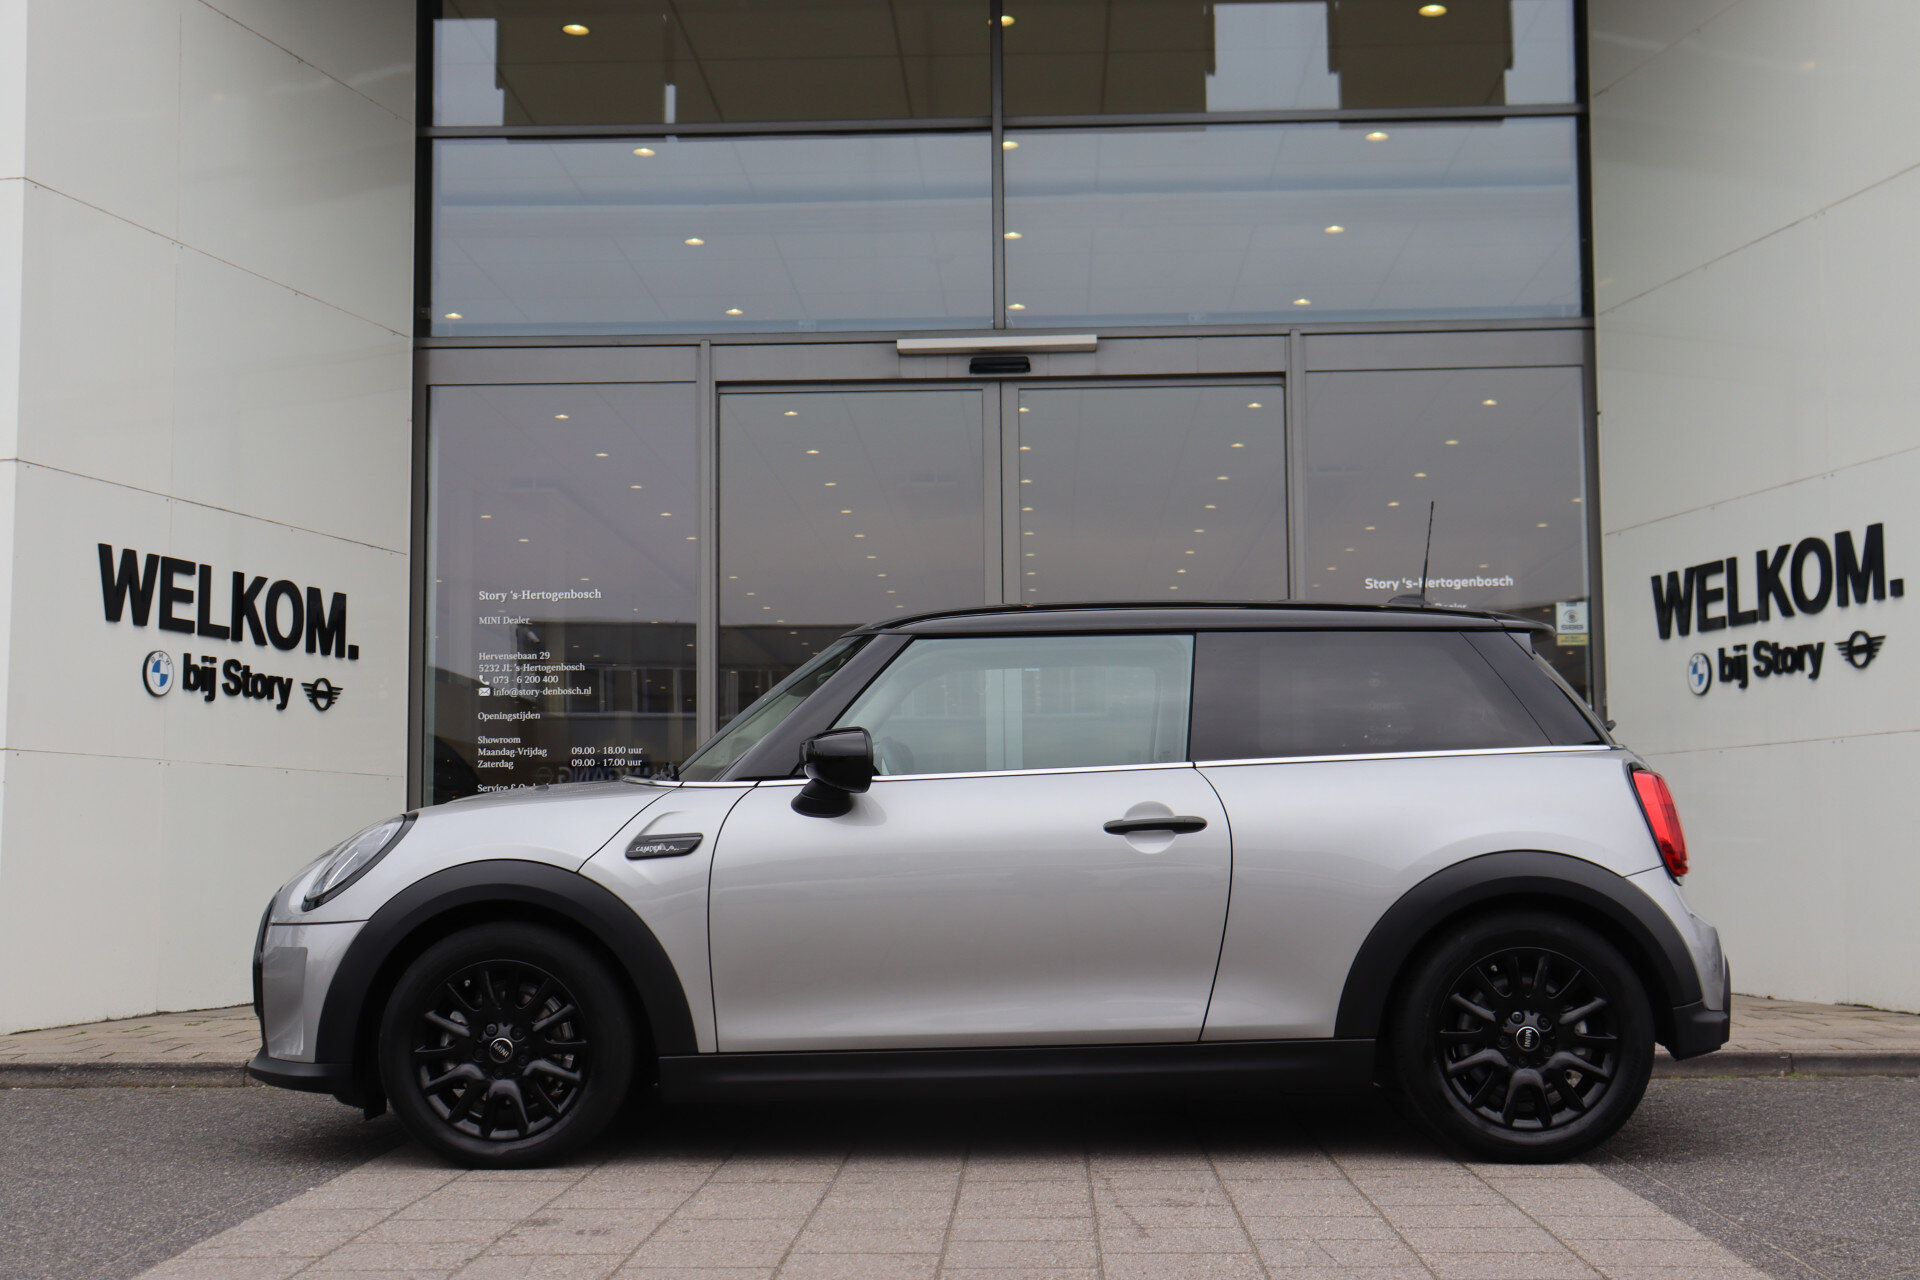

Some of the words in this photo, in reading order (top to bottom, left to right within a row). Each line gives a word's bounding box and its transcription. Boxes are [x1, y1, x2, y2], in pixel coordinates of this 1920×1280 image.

[1365, 577, 1399, 591] Story
[1651, 522, 1904, 640] WELKOM.
[98, 543, 359, 660] WELKOM.
[478, 590, 507, 602] Story
[478, 616, 501, 625] MINI
[503, 616, 530, 625] Dealer
[478, 652, 537, 661] Hervensebaan
[539, 651, 551, 660] 29
[478, 664, 500, 673] 5232
[501, 664, 512, 672] JL
[1718, 644, 1748, 689] bij
[1753, 640, 1825, 681] Story
[182, 653, 217, 702] bij
[222, 658, 293, 711] Story
[493, 675, 509, 684] 073
[516, 675, 522, 684] 6
[524, 675, 541, 684] 200
[542, 675, 559, 684] 400
[493, 686, 592, 697] info@story-denbosch.nl
[477, 711, 541, 721] Openingstijden
[477, 736, 521, 744] Showroom
[477, 748, 548, 757] Maandag-Vrijdag
[571, 746, 595, 755] 09.00
[603, 746, 627, 755] 18.00
[477, 760, 514, 769] Zaterdag
[571, 758, 595, 767] 09.00
[603, 758, 626, 767] 17.00
[477, 784, 509, 792] Service
[1523, 1029, 1532, 1048] MINI
[493, 1042, 510, 1058] MINI
